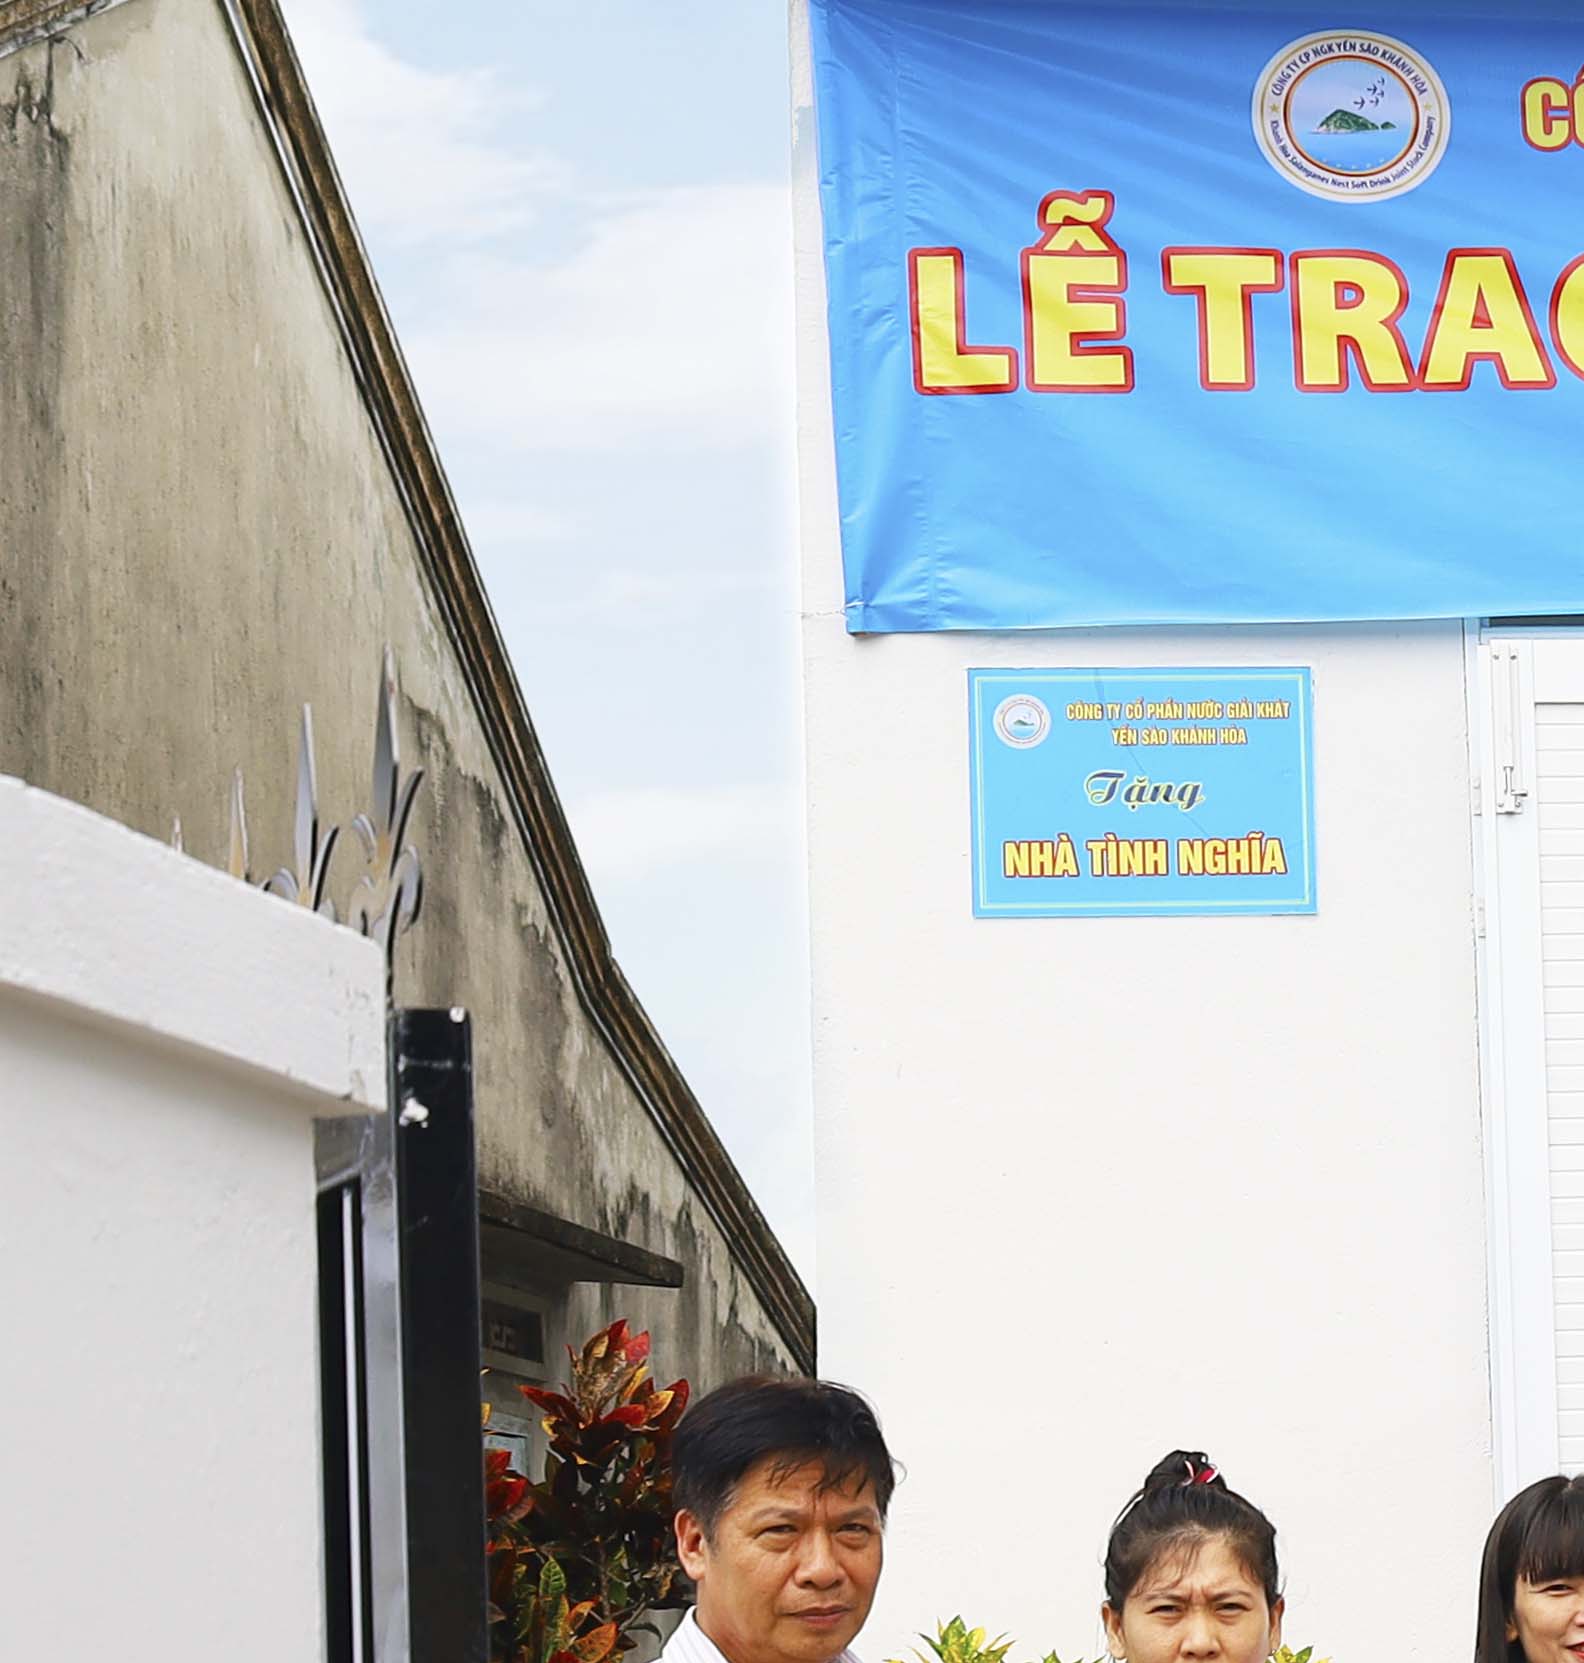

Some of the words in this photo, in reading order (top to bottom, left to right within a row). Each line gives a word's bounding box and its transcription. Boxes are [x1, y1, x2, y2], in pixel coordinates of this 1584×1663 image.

[1271, 71, 1292, 97] CÔNG
[1288, 60, 1300, 74] TY
[1300, 51, 1312, 64] CP
[1313, 43, 1335, 57] NGK
[1359, 42, 1380, 56] SÀO
[1380, 50, 1413, 76] KHÁNH
[1410, 75, 1429, 95] HÒA
[906, 190, 1135, 395] LỄ
[1085, 769, 1204, 811] Tặng
[1003, 833, 1080, 878] NHÀ
[1087, 833, 1166, 877] TÌNH
[1178, 831, 1288, 875] NGHĨA
